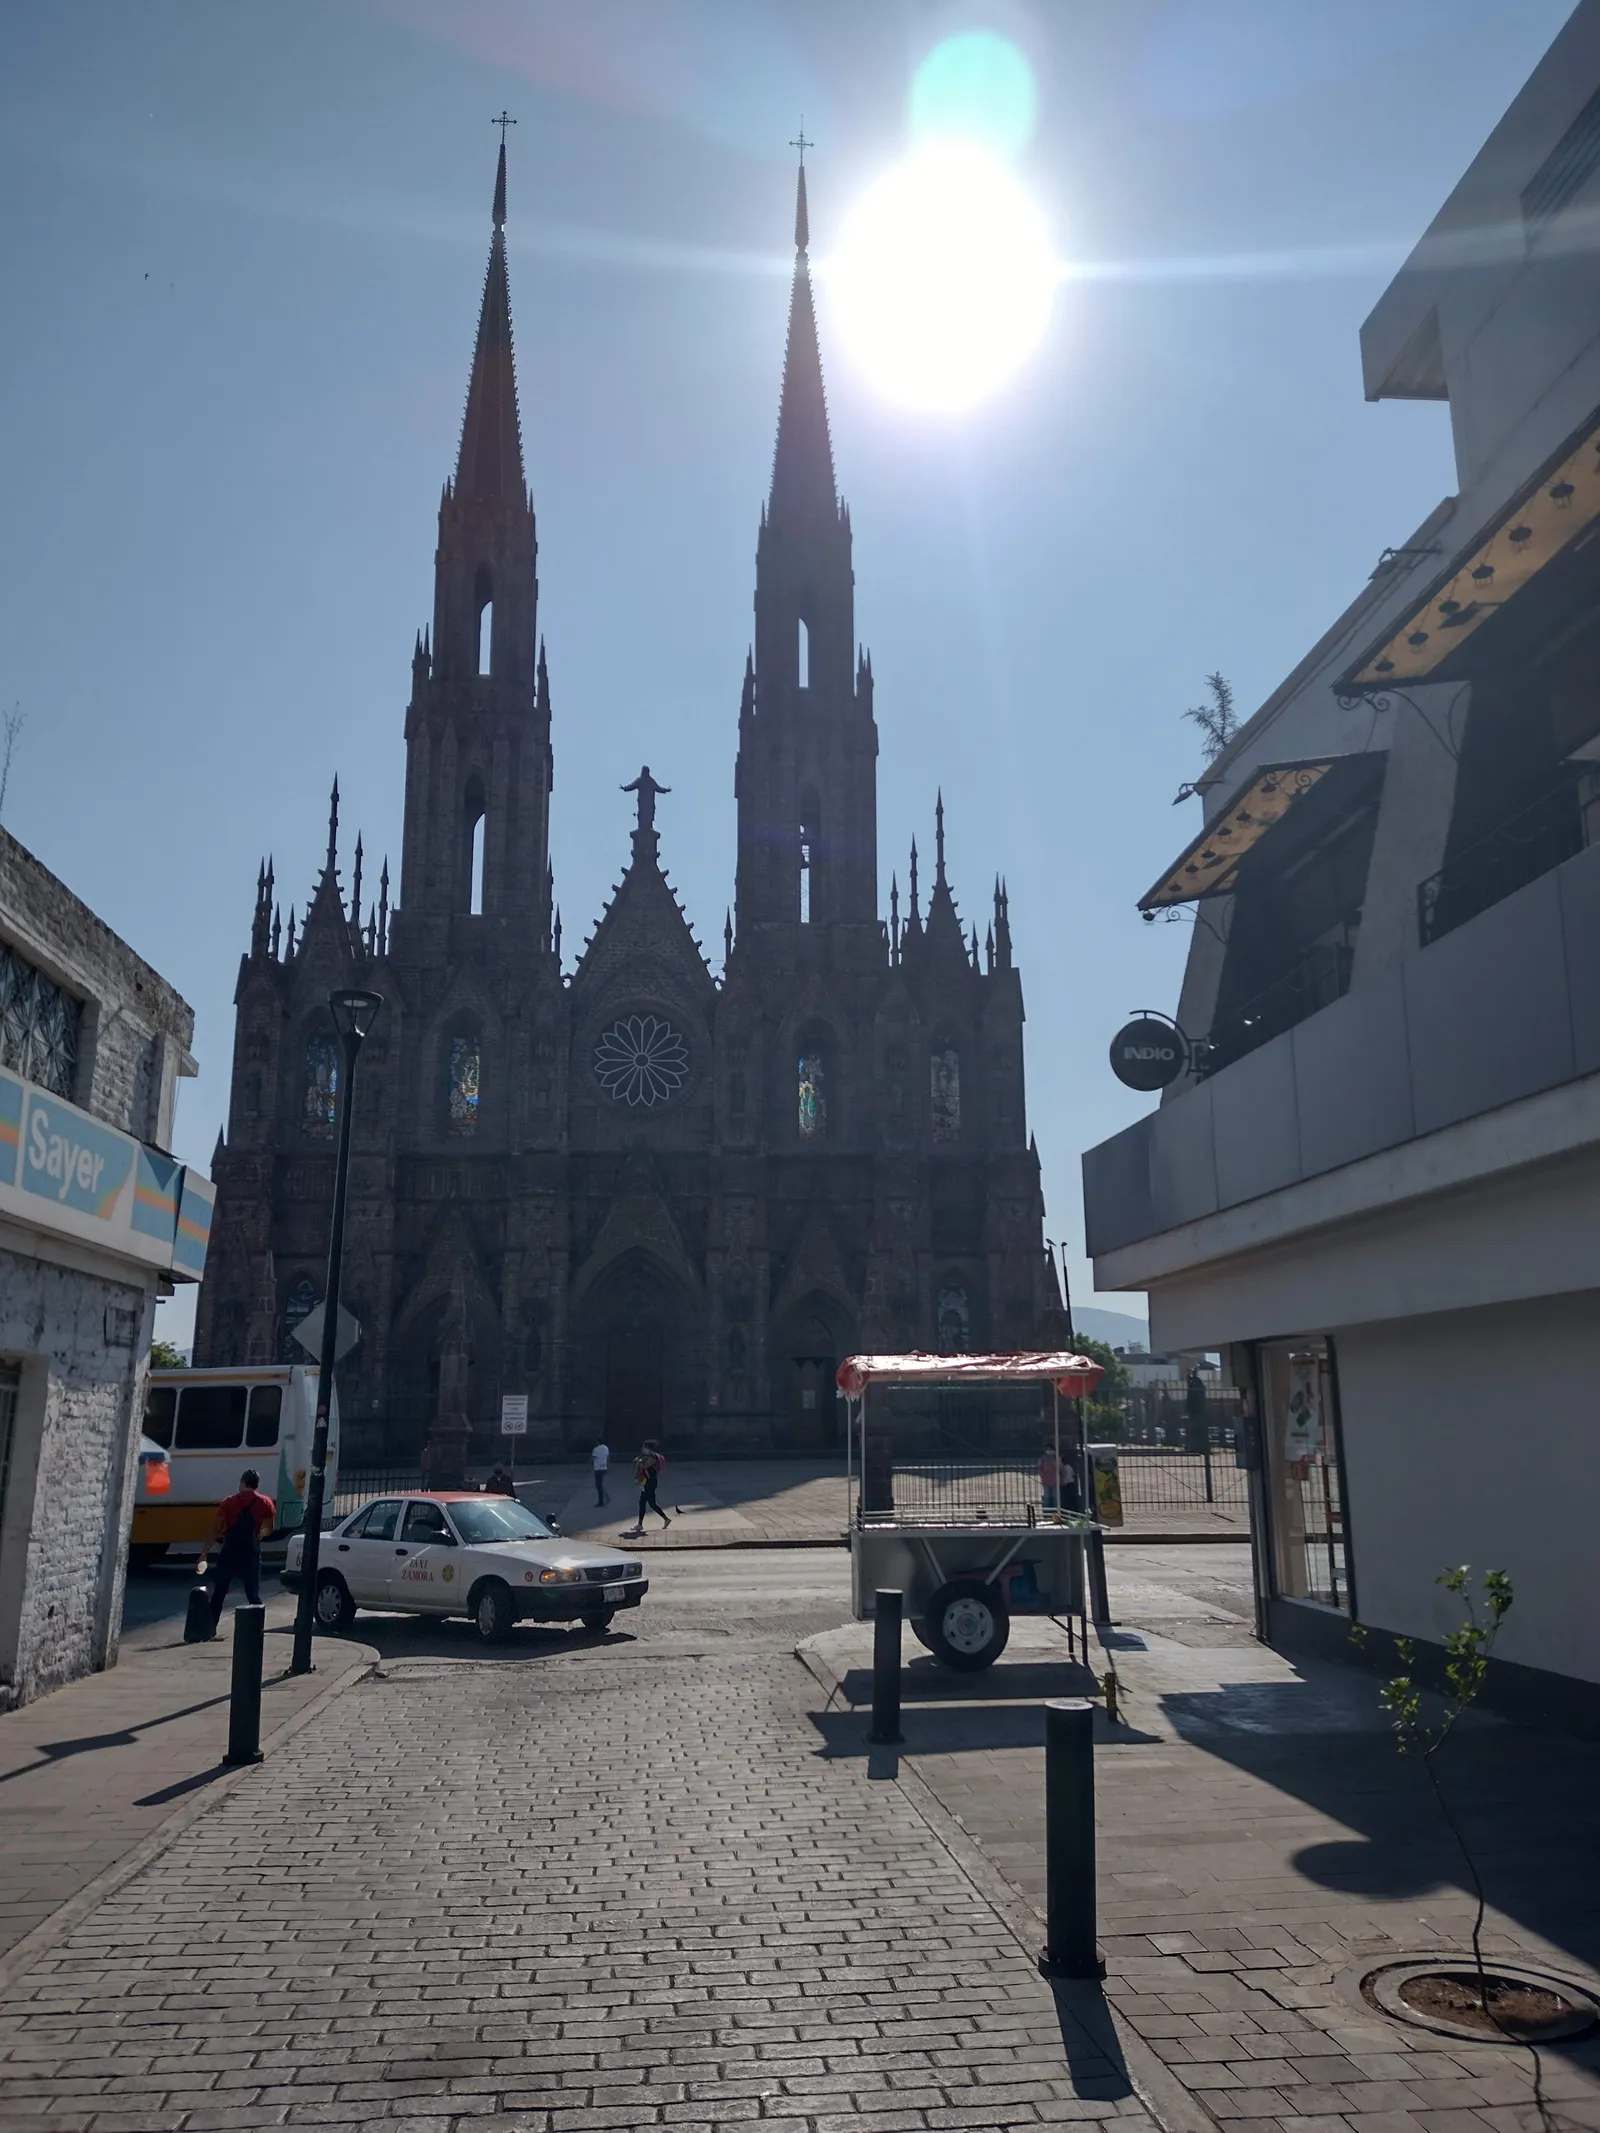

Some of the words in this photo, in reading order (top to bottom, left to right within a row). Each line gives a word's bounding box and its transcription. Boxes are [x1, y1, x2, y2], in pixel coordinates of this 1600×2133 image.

[1124, 1046, 1175, 1060] INDIO
[28, 1108, 105, 1200] Sayer
[409, 1559, 428, 1569] TAXI
[401, 1569, 434, 1582] ZAMORA
